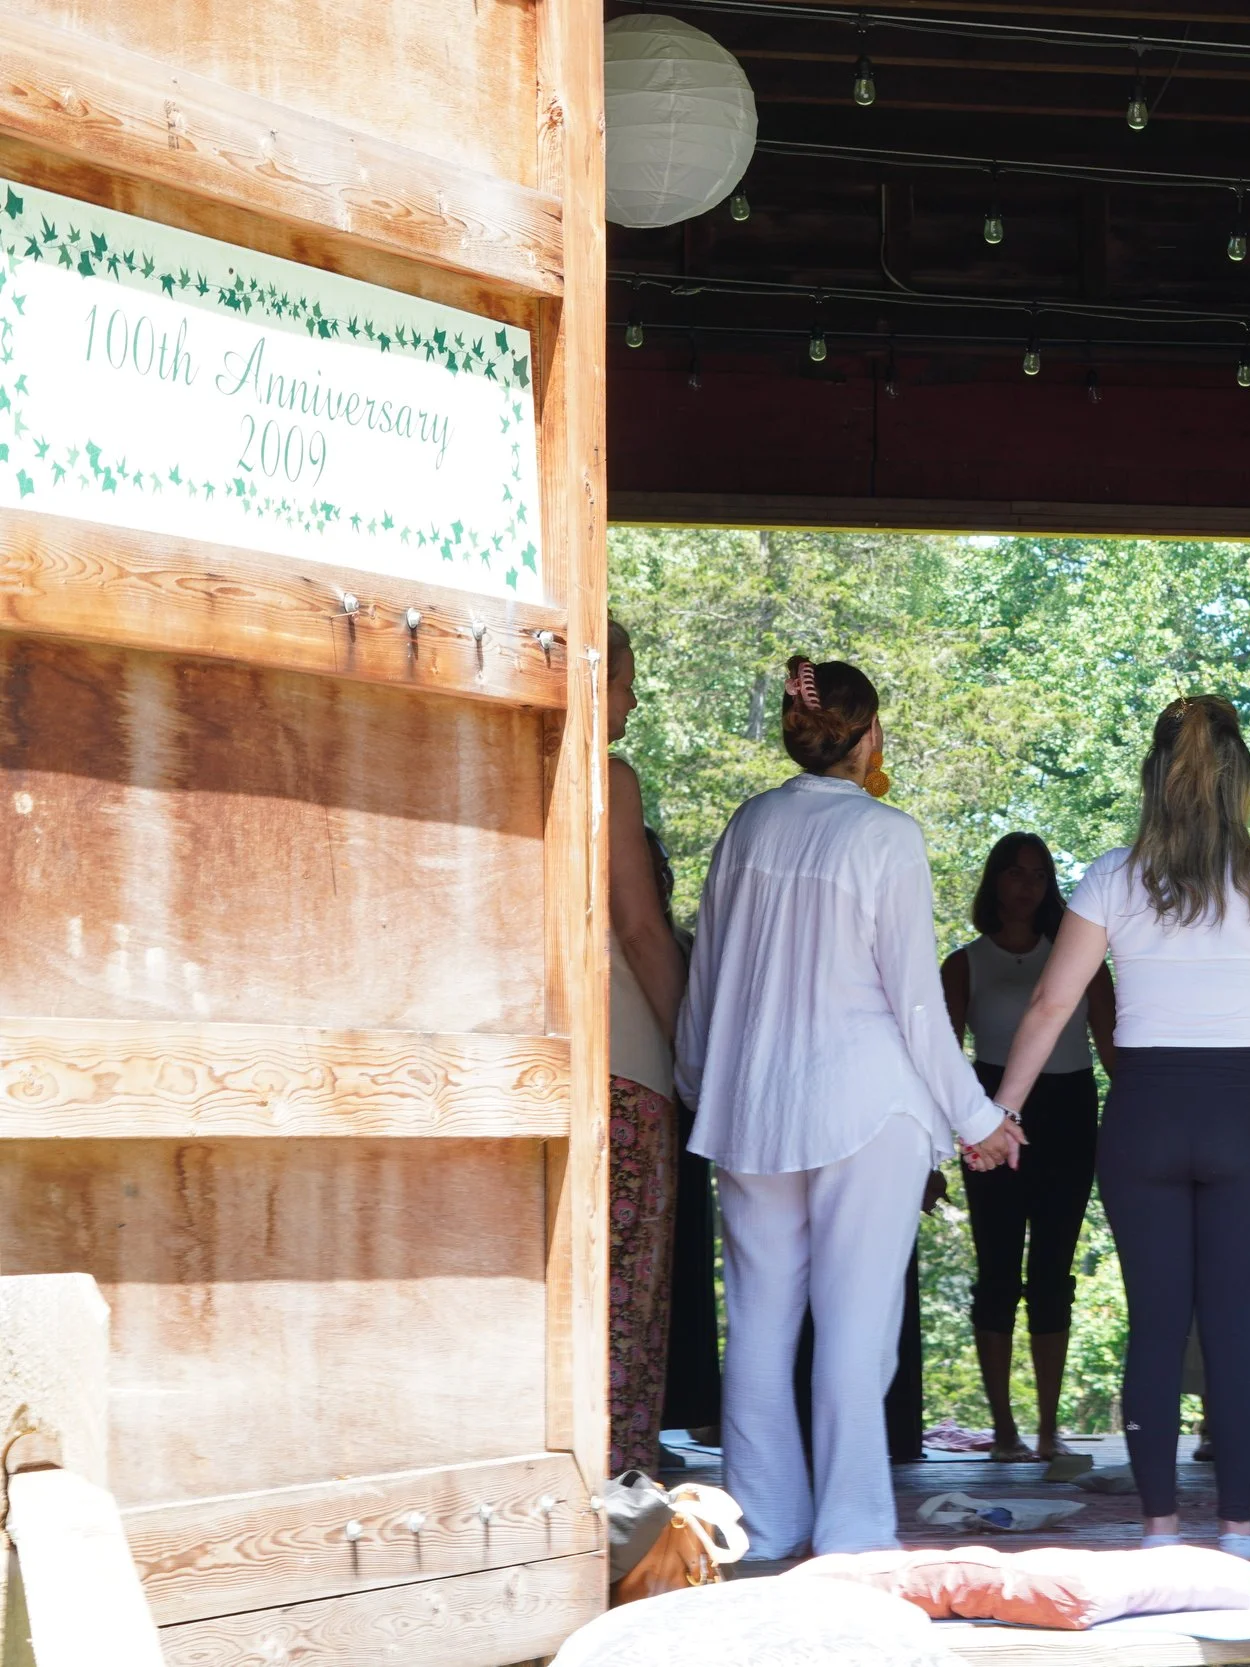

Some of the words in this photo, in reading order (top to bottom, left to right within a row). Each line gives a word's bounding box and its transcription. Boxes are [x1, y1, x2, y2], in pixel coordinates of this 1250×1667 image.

[84, 304, 201, 387] 100th
[215, 337, 455, 471] Anniversary
[236, 413, 328, 488] 2009
